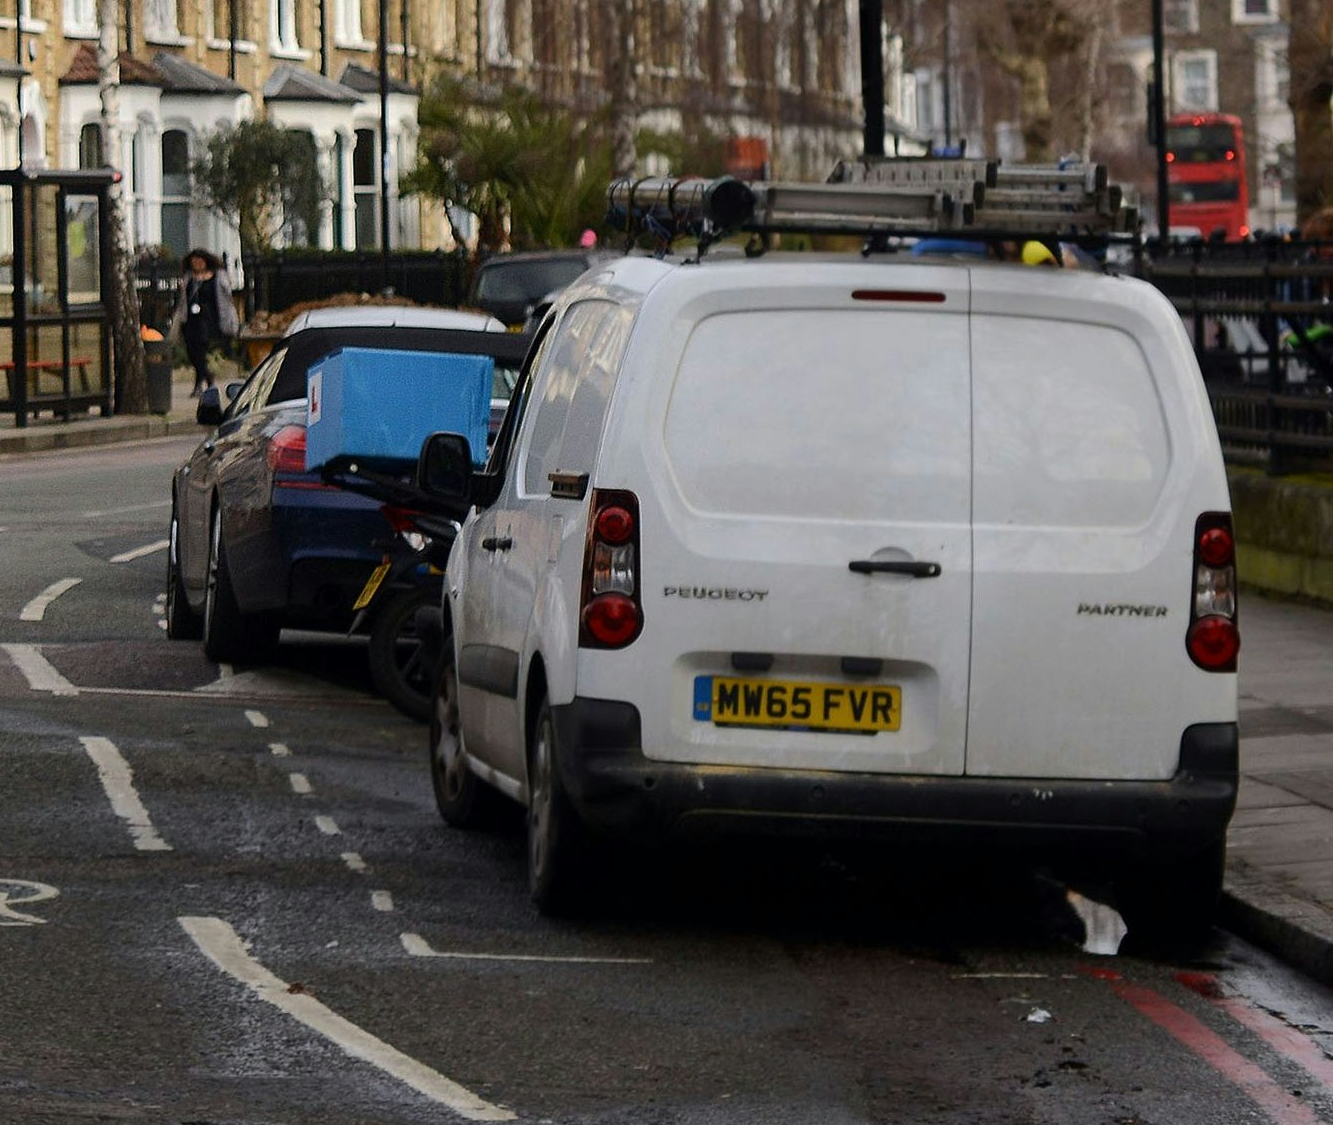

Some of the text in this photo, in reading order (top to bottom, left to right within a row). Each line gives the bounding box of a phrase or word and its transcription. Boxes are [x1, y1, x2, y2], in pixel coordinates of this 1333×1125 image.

[663, 586, 769, 602] PEUGEOT
[1077, 602, 1168, 618] PARTNER
[717, 683, 893, 724] MW65 FVR
